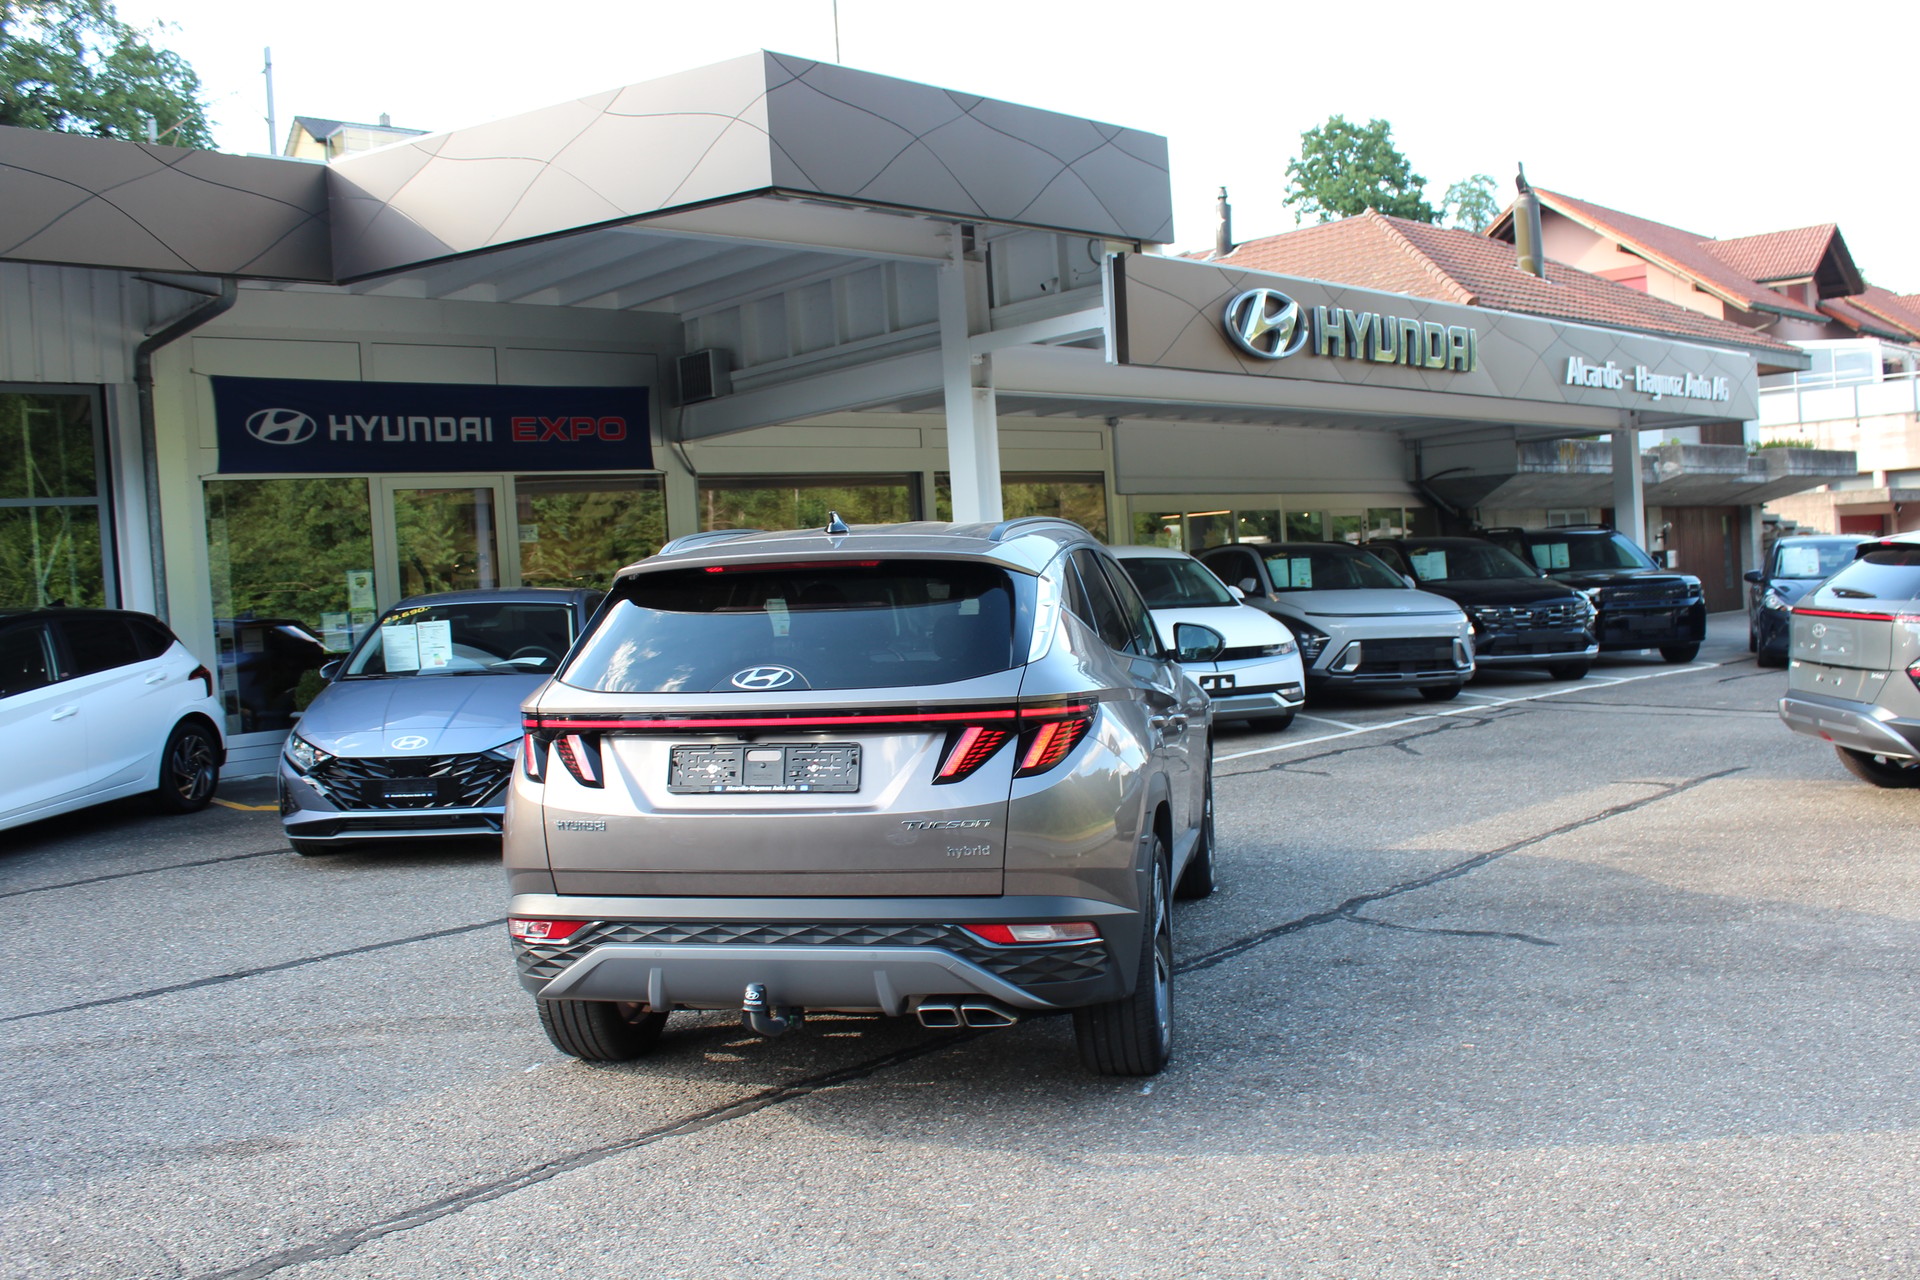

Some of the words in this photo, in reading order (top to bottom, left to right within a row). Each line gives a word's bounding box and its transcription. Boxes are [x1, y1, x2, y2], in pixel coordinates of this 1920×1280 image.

[1313, 305, 1477, 373] HYUNDAI
[1566, 355, 1624, 390] Alcardis
[1635, 365, 1685, 401] Haymoz
[1685, 371, 1712, 399] Auto
[1712, 375, 1730, 402] AG
[328, 414, 493, 442] HYUNDAI
[511, 416, 627, 442] EXPO
[556, 820, 607, 832] HYUNDAI
[901, 819, 991, 831] TUCSON
[946, 845, 991, 859] hybrid
